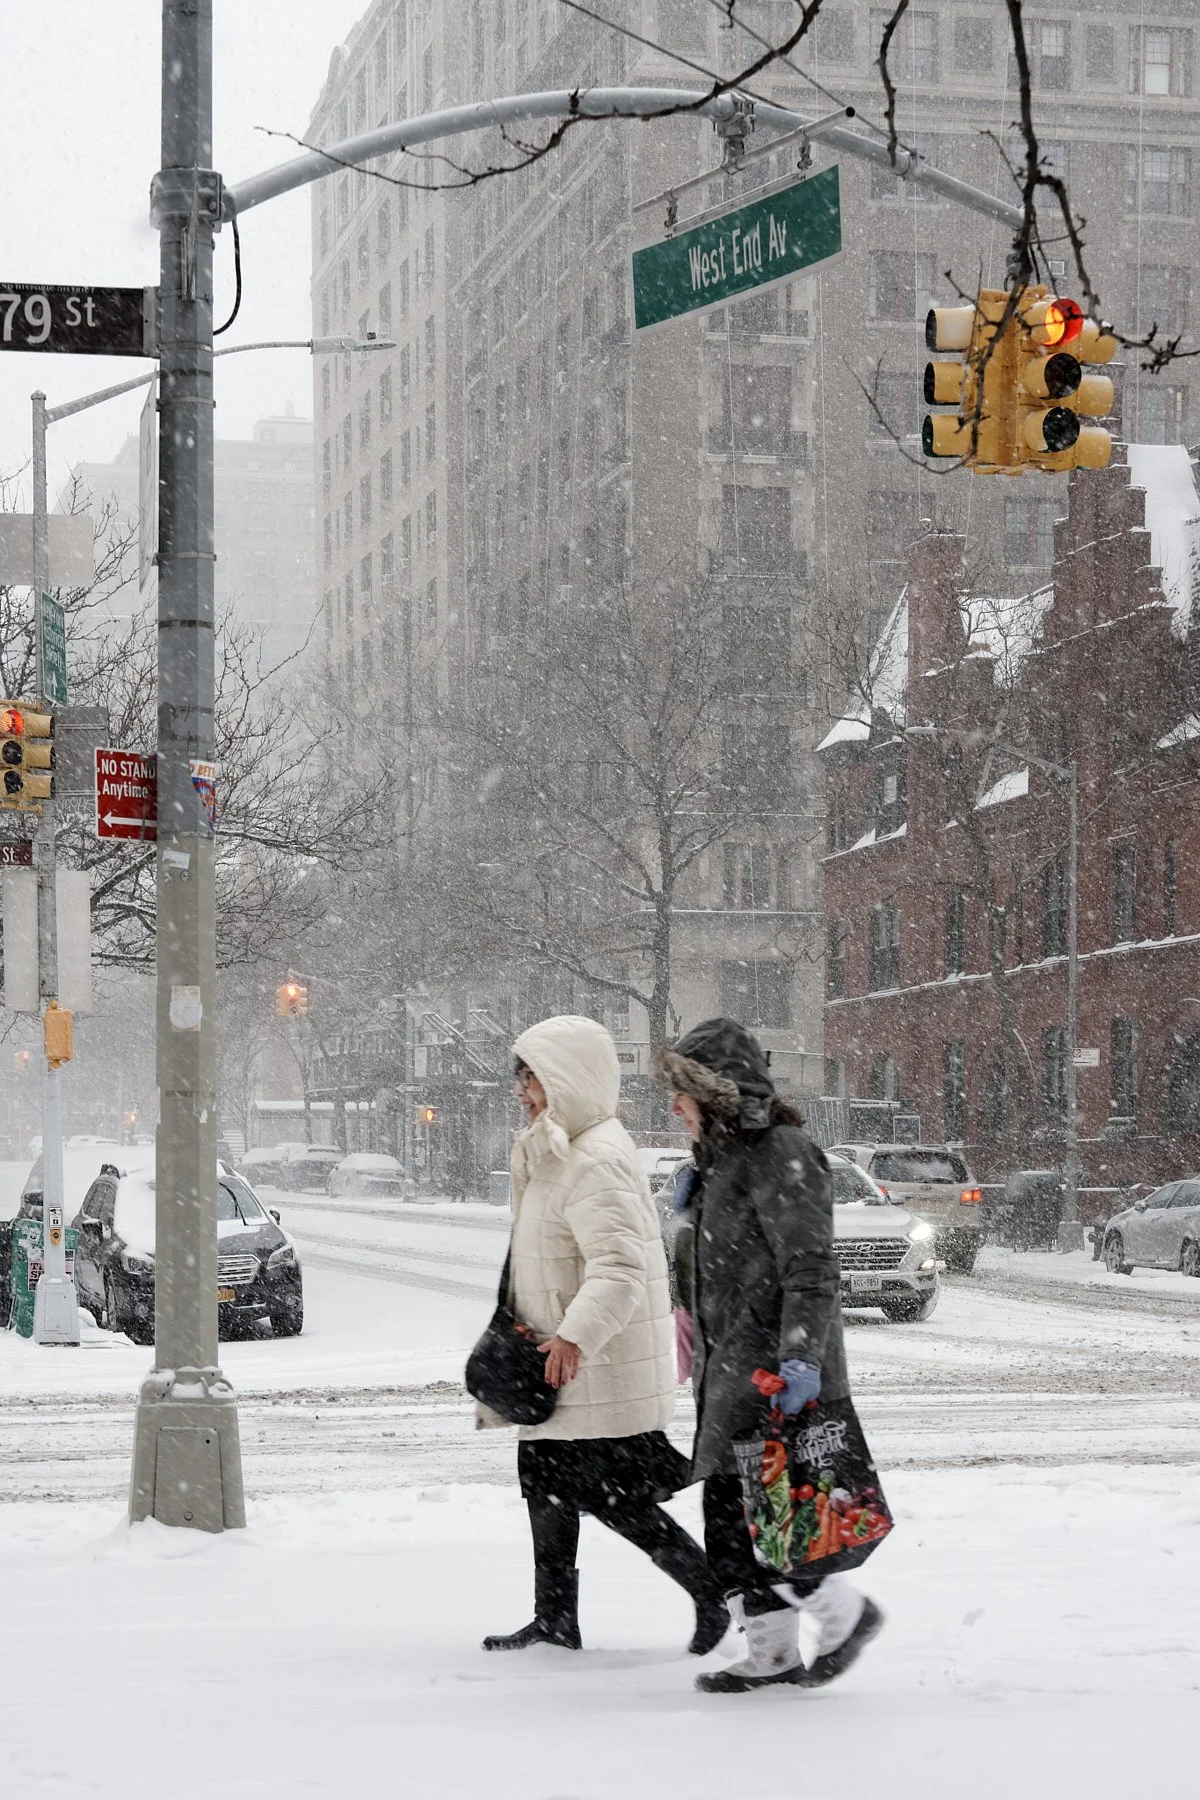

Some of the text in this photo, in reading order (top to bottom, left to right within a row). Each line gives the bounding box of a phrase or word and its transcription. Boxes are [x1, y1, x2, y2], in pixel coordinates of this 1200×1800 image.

[688, 214, 787, 291] West End Av
[0, 294, 96, 344] 79 St
[101, 758, 118, 776] NO
[102, 779, 149, 800] Anytime
[2, 846, 15, 863] St
